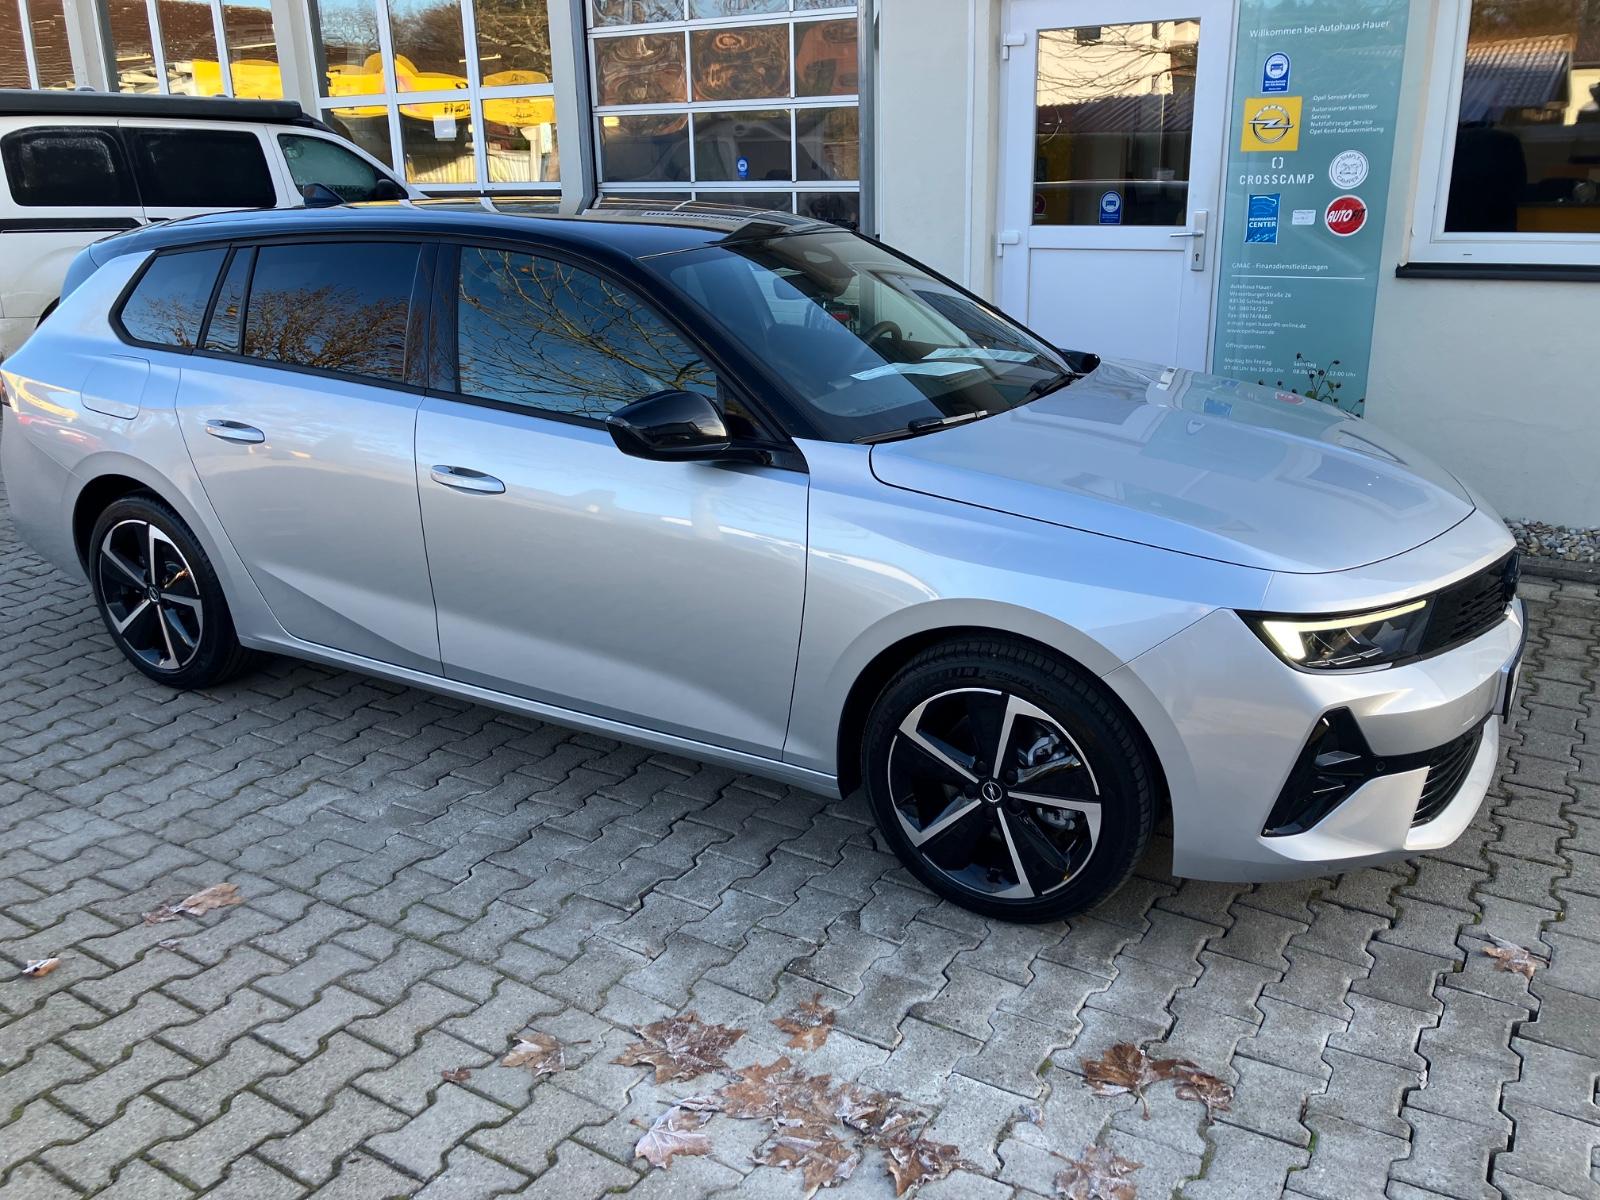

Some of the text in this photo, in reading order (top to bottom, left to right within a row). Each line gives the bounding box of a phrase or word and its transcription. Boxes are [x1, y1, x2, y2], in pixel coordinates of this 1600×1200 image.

[1249, 20, 1390, 37] Willkommen bei Autohaus Hauer
[1239, 173, 1315, 185] CROSSCAMP
[1256, 263, 1328, 271] Finanzdienstleistungen
